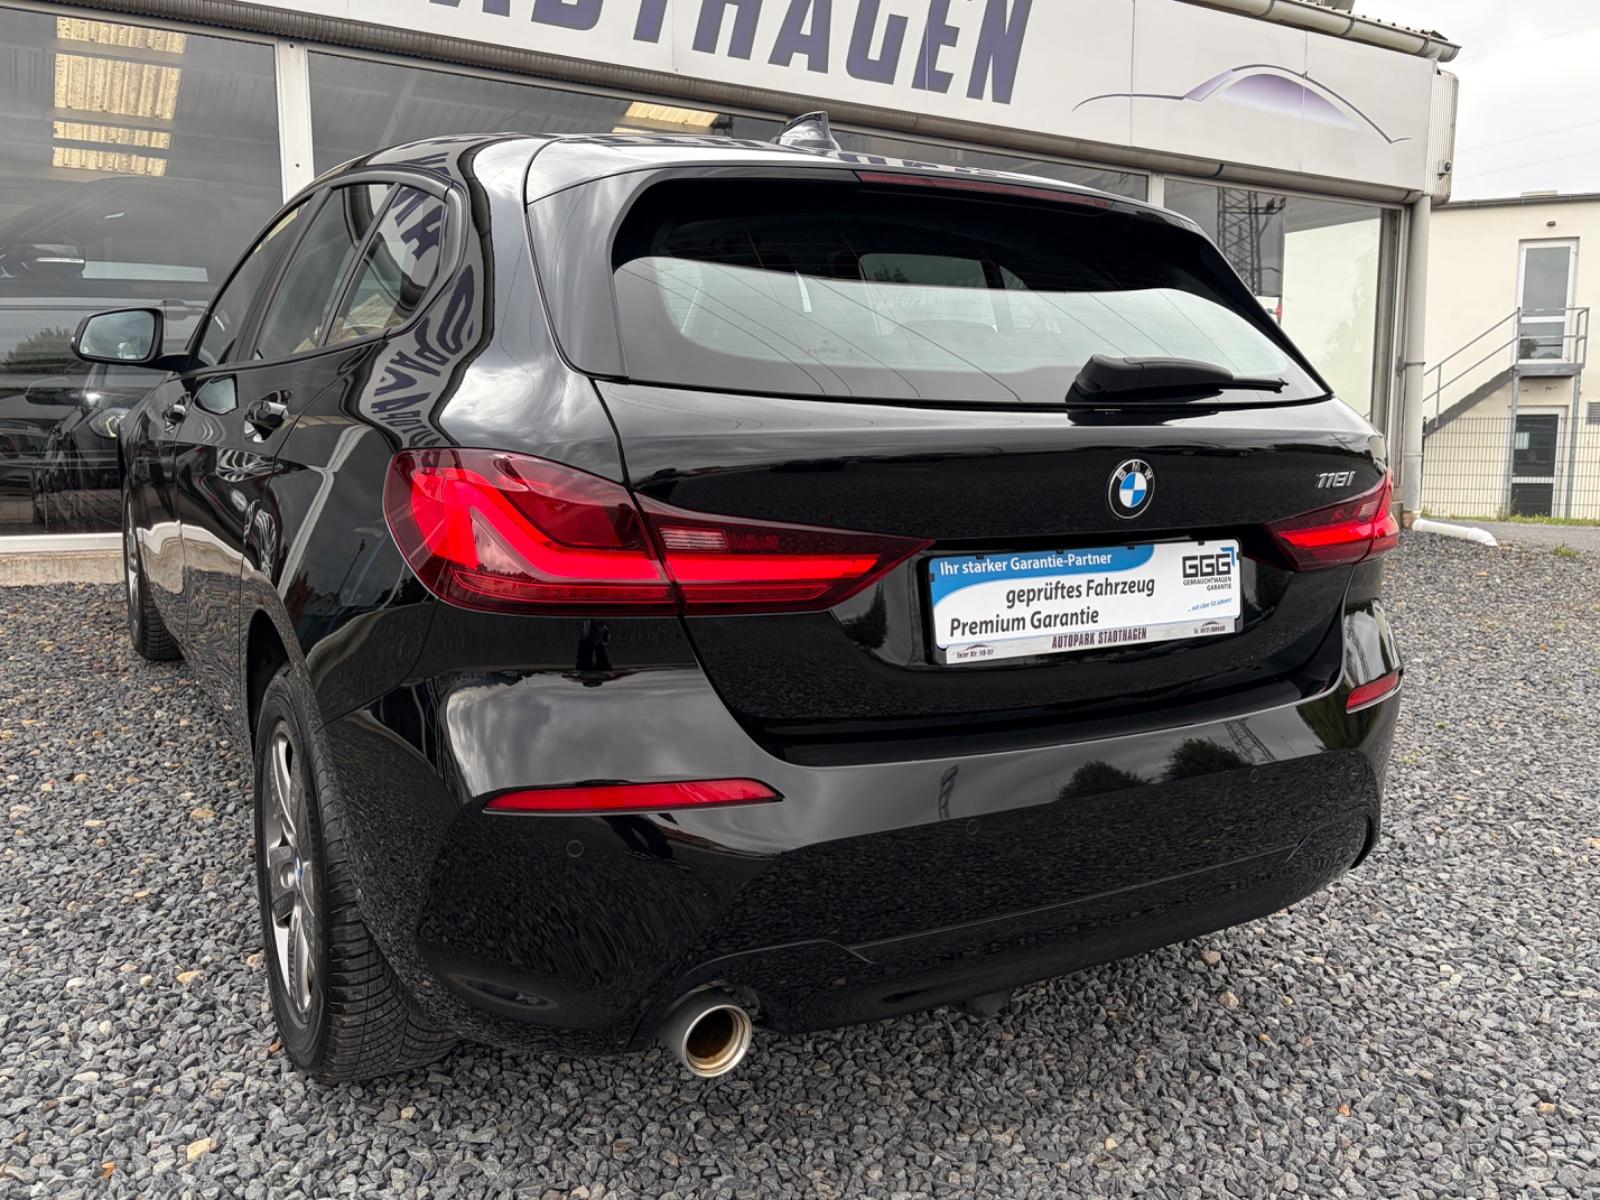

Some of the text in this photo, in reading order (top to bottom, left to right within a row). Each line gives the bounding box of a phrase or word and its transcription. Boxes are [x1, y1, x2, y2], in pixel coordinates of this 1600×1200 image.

[429, 0, 1033, 105] HAGEN
[1116, 461, 1154, 480] BMW
[1315, 471, 1356, 489] 118i
[939, 552, 1112, 576] Ihr starker Garantie-Partner
[1182, 553, 1231, 578] GGG
[1005, 576, 1156, 609] geprüftes Fahrzeug
[1183, 576, 1232, 586] GEBRAUCHTWAGEN
[949, 607, 1099, 638] Premium Garantie
[1051, 627, 1147, 649] AUTOPARK STADTHAGEN
